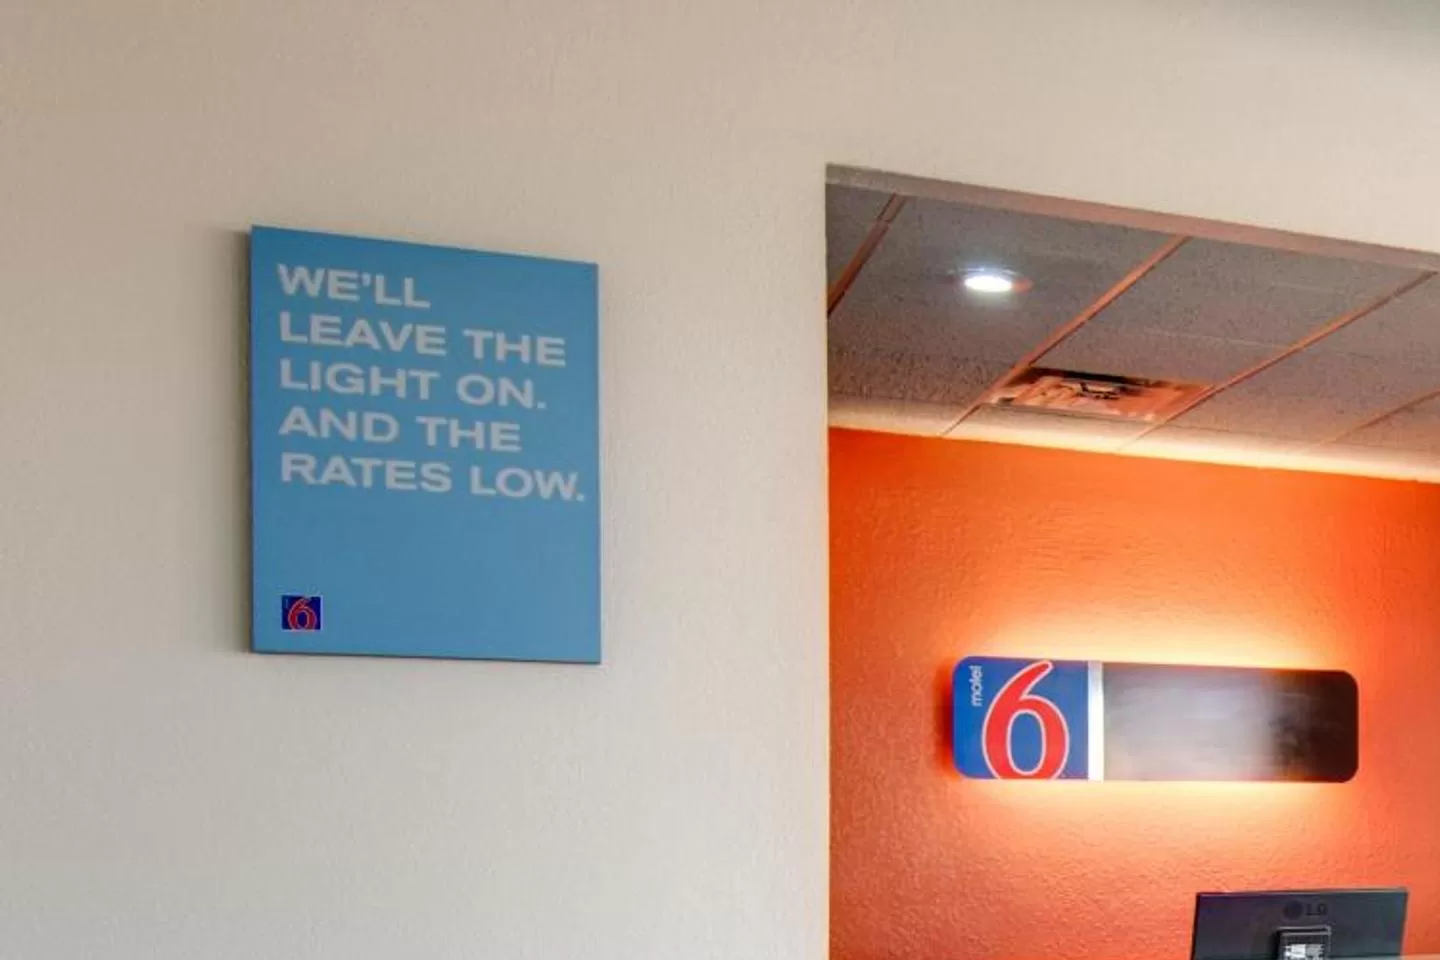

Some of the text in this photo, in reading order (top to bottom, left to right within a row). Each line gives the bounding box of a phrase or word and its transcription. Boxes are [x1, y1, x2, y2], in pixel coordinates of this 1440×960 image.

[277, 264, 430, 308] WE'LL
[279, 312, 566, 367] LEAVE THE
[279, 359, 547, 409] LIGHT ON.
[278, 407, 522, 452] AND THE
[281, 453, 585, 502] RATES LOW.
[288, 597, 317, 632] 6
[969, 659, 1070, 780] motel 6
